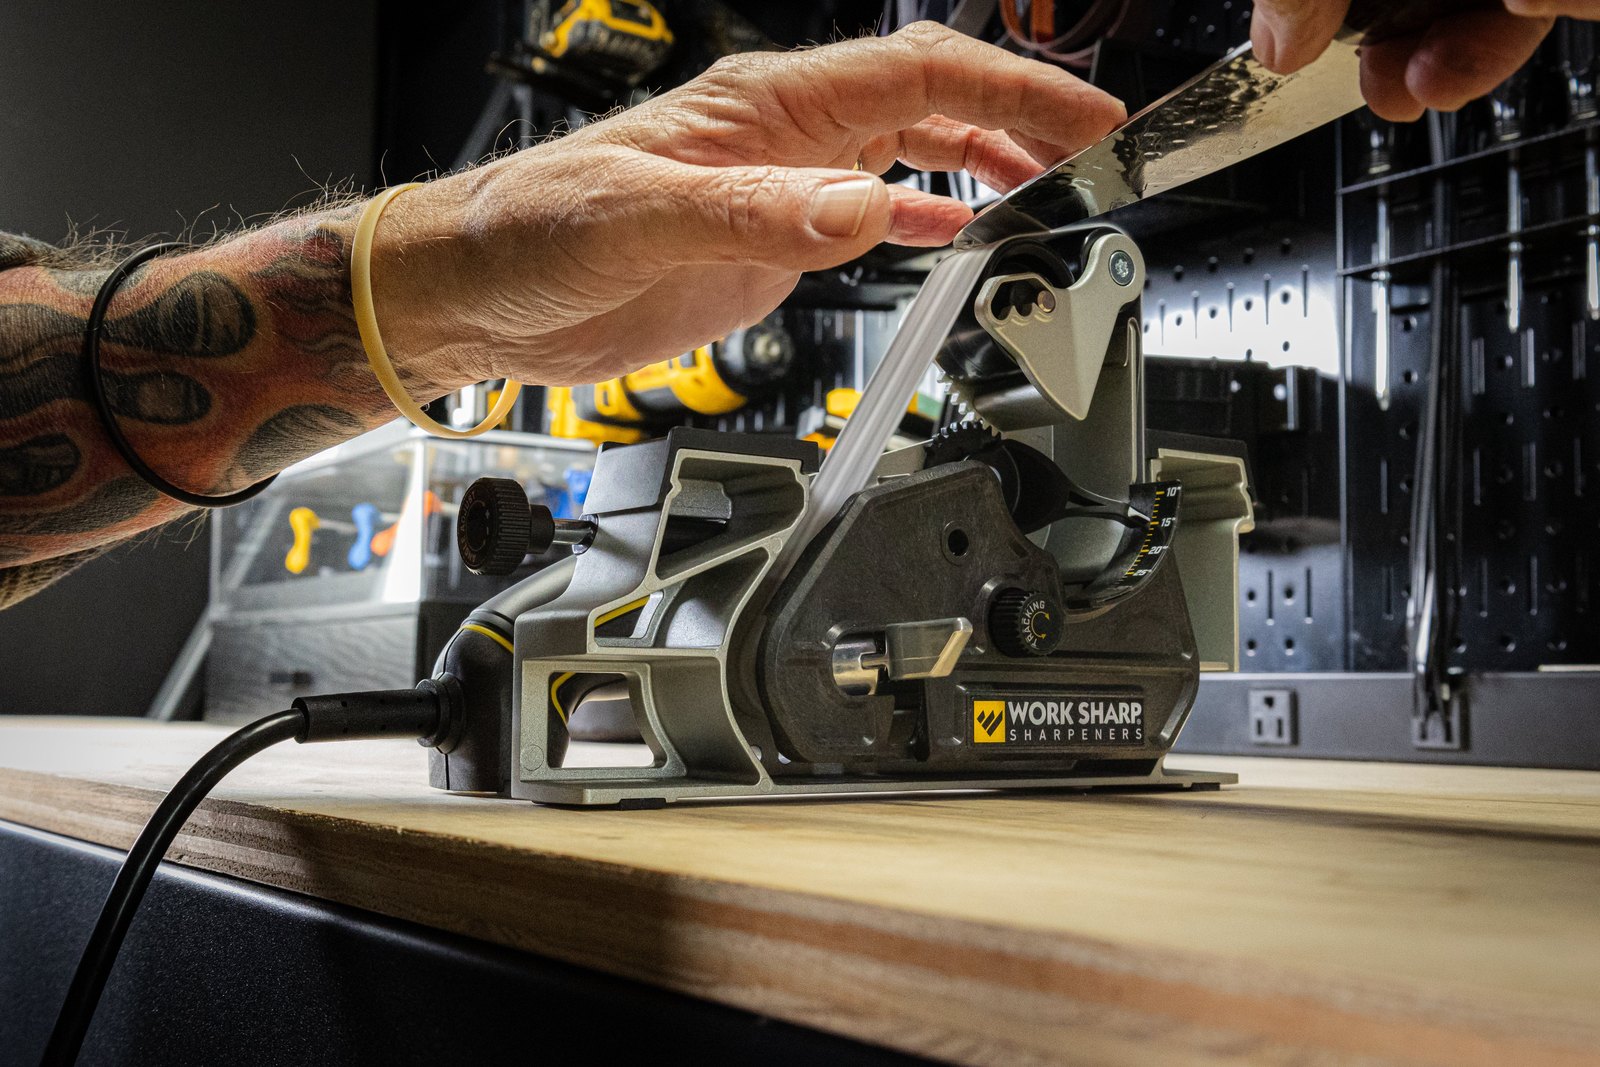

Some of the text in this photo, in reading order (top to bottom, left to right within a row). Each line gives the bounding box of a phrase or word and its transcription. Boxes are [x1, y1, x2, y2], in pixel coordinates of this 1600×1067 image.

[1022, 600, 1046, 649] TRACKING
[1008, 701, 1074, 725] WORK
[1010, 728, 1142, 741] SHARPENERS
